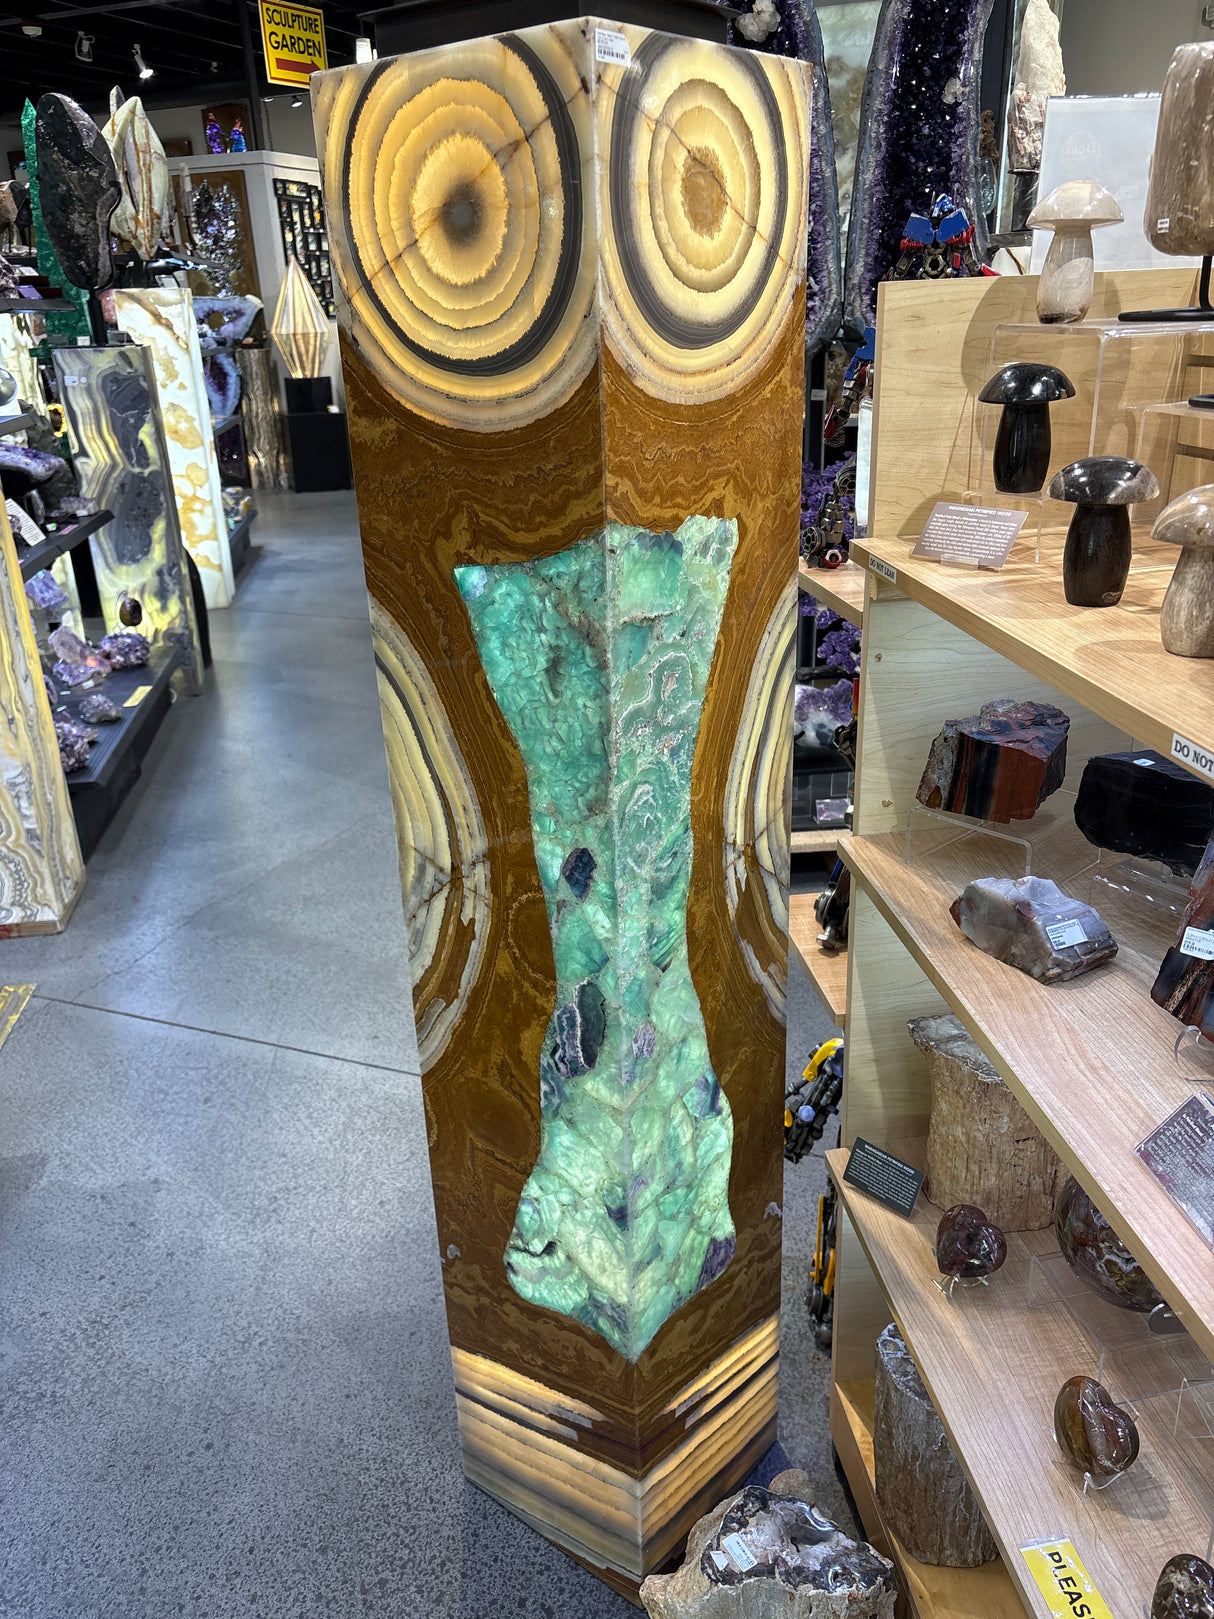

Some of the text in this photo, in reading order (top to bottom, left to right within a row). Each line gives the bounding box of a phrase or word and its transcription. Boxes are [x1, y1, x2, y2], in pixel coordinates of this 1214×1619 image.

[265, 7, 320, 34] SCULPTURE
[268, 31, 322, 58] GARDEN
[975, 508, 997, 516] PETRIFIED
[870, 558, 876, 568] DO
[876, 562, 884, 573] NOT
[1174, 740, 1214, 772] DO NOT
[1048, 1551, 1095, 1619] PLEAS
